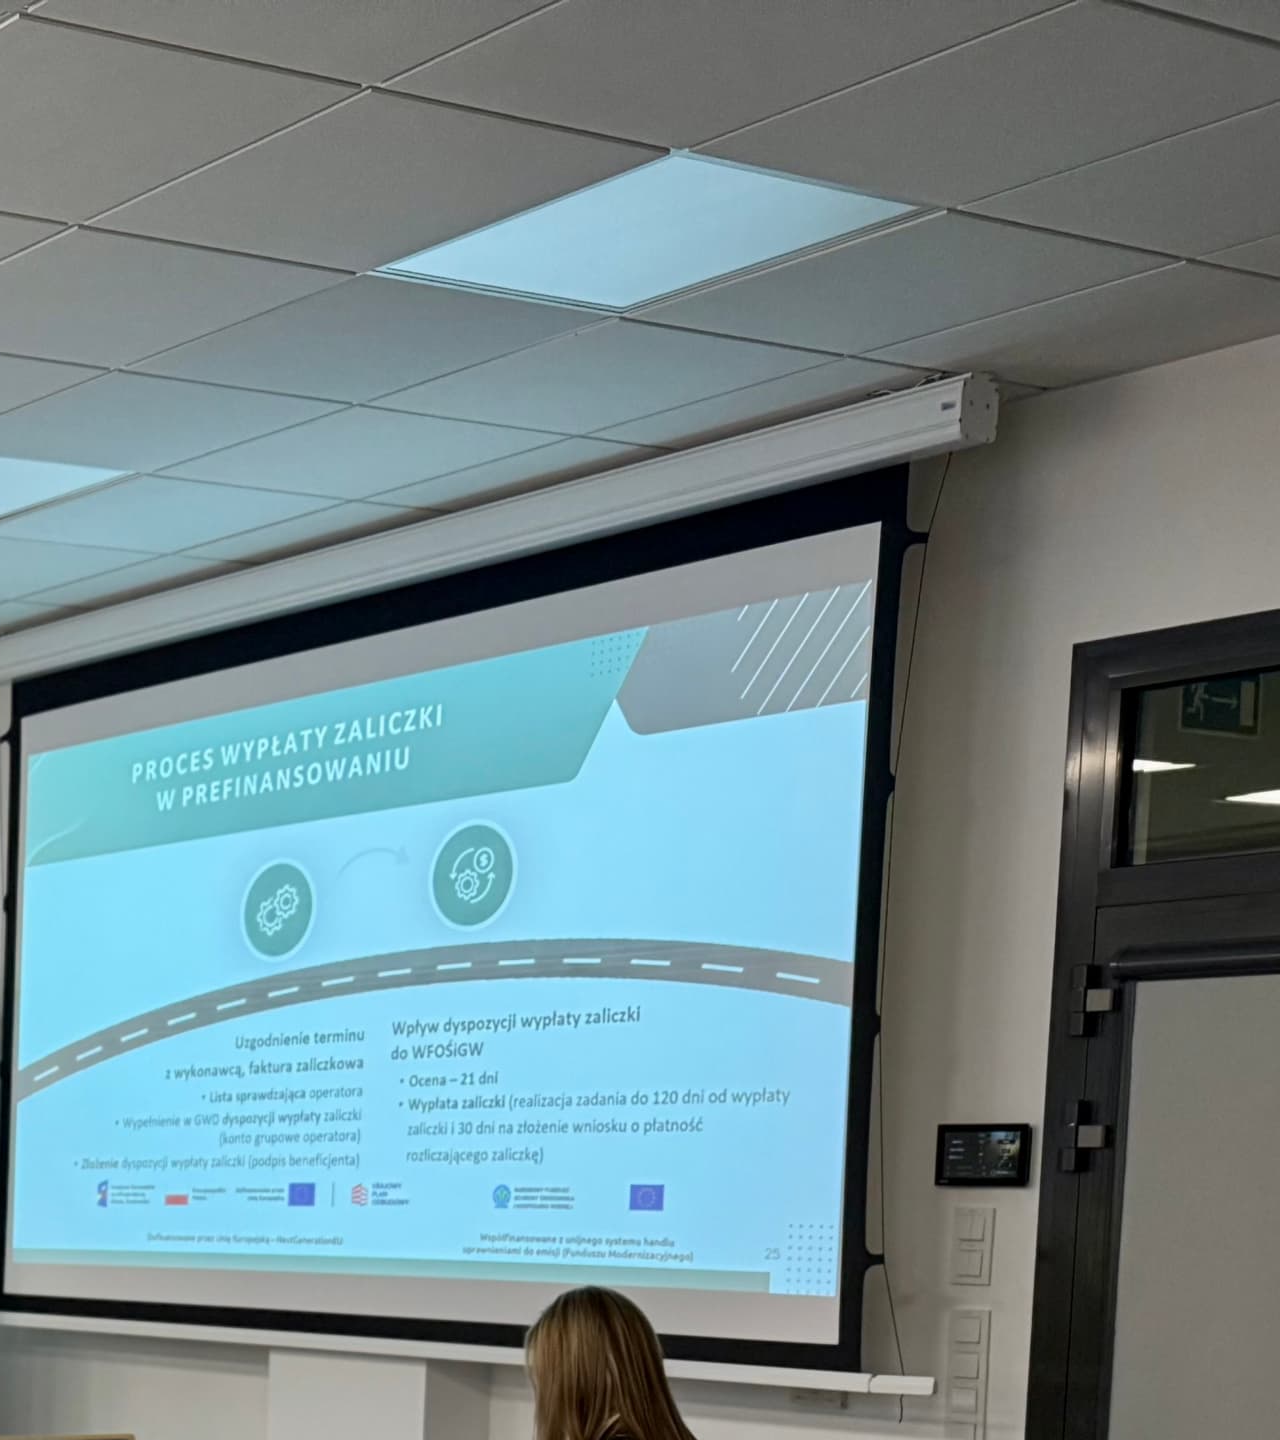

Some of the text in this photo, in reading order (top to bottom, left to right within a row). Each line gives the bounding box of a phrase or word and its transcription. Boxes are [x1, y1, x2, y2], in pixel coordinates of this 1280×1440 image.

[132, 704, 443, 784] PROCES WYPŁATY ZALICZKI
[156, 747, 410, 812] W PREFINANSOWANIU
[392, 1006, 641, 1038] Wpływ dyspozycji wypłaty zaliczki
[235, 1029, 365, 1051] Uzgodnienie terminu
[391, 1041, 484, 1060] do WFOŚiGW
[174, 1064, 245, 1081] wykonawcą,
[248, 1060, 292, 1075] faktura
[296, 1057, 364, 1073] zaliczkowa
[409, 1074, 446, 1088] Ocena
[460, 1073, 475, 1086] 21
[478, 1071, 499, 1086] dni
[209, 1086, 363, 1104] Lista sprawdzająca operatora
[408, 1087, 791, 1114] Wypłata zaliczki (realizacja zadania do 120 dni od wypłaty
[222, 1111, 275, 1127] dyspozycji
[278, 1110, 321, 1126] wypłaty
[324, 1107, 362, 1122] zaliczki
[407, 1121, 447, 1137] zaliczki
[457, 1121, 473, 1135] 30
[475, 1120, 495, 1135] dni
[498, 1123, 514, 1134] na
[517, 1118, 569, 1135] złożenie
[572, 1118, 627, 1134] wniosku
[631, 1122, 640, 1133] o
[643, 1116, 704, 1137] płatność
[219, 1128, 361, 1148] (konto grupowe operatora)
[211, 1154, 245, 1168] zaliczki
[248, 1153, 286, 1170] (podpis
[289, 1152, 360, 1169] beneficjenta)
[406, 1147, 544, 1165] rozliczającego zaliczkę)
[764, 1247, 781, 1261] 25
